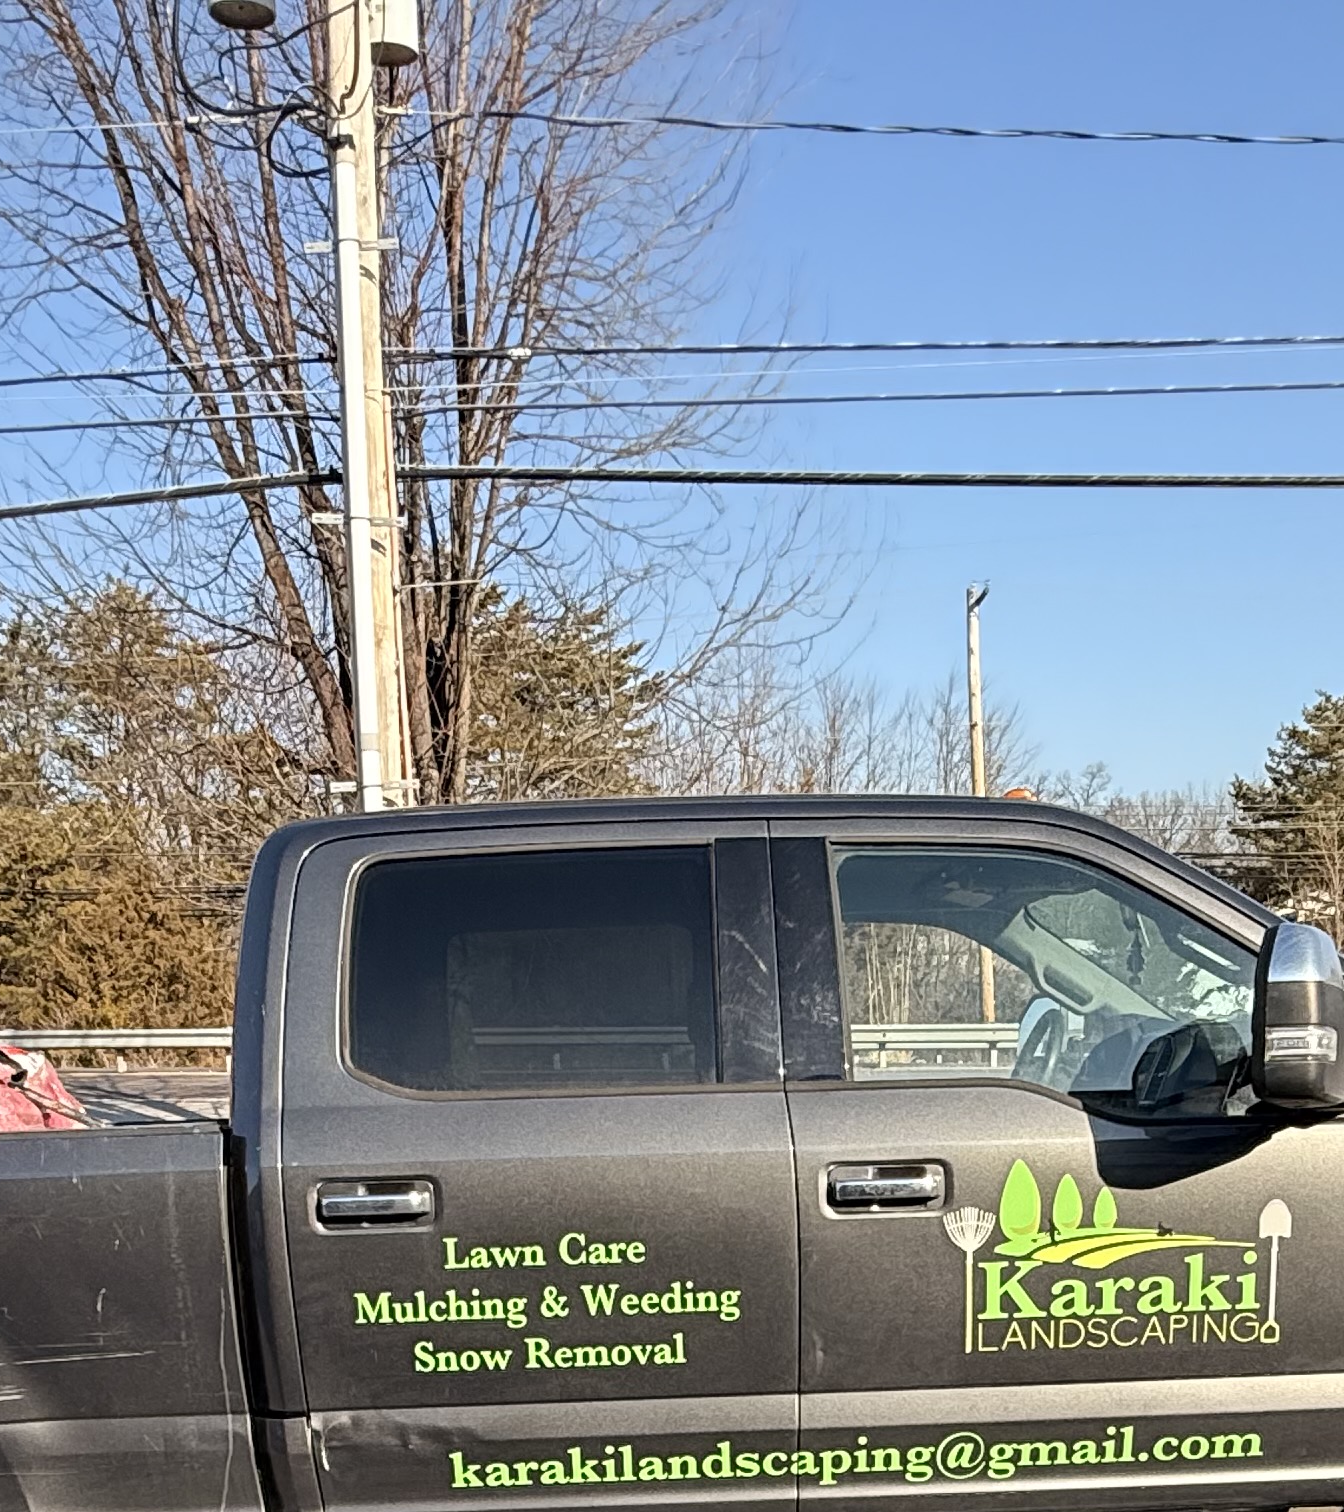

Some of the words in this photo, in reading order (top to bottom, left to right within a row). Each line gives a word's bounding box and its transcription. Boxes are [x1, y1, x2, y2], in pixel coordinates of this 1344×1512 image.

[443, 1237, 546, 1270] Lawn
[558, 1232, 646, 1265] Care
[354, 1288, 528, 1329] Mulching
[540, 1286, 569, 1318] &
[581, 1281, 742, 1321] Weeding
[977, 1250, 1261, 1320] Karaki
[414, 1342, 512, 1372] Snow
[524, 1332, 687, 1368] Removal
[977, 1312, 1261, 1352] LANDSCAPING
[449, 1425, 1264, 1488] karakilandscaping@gmail.com
